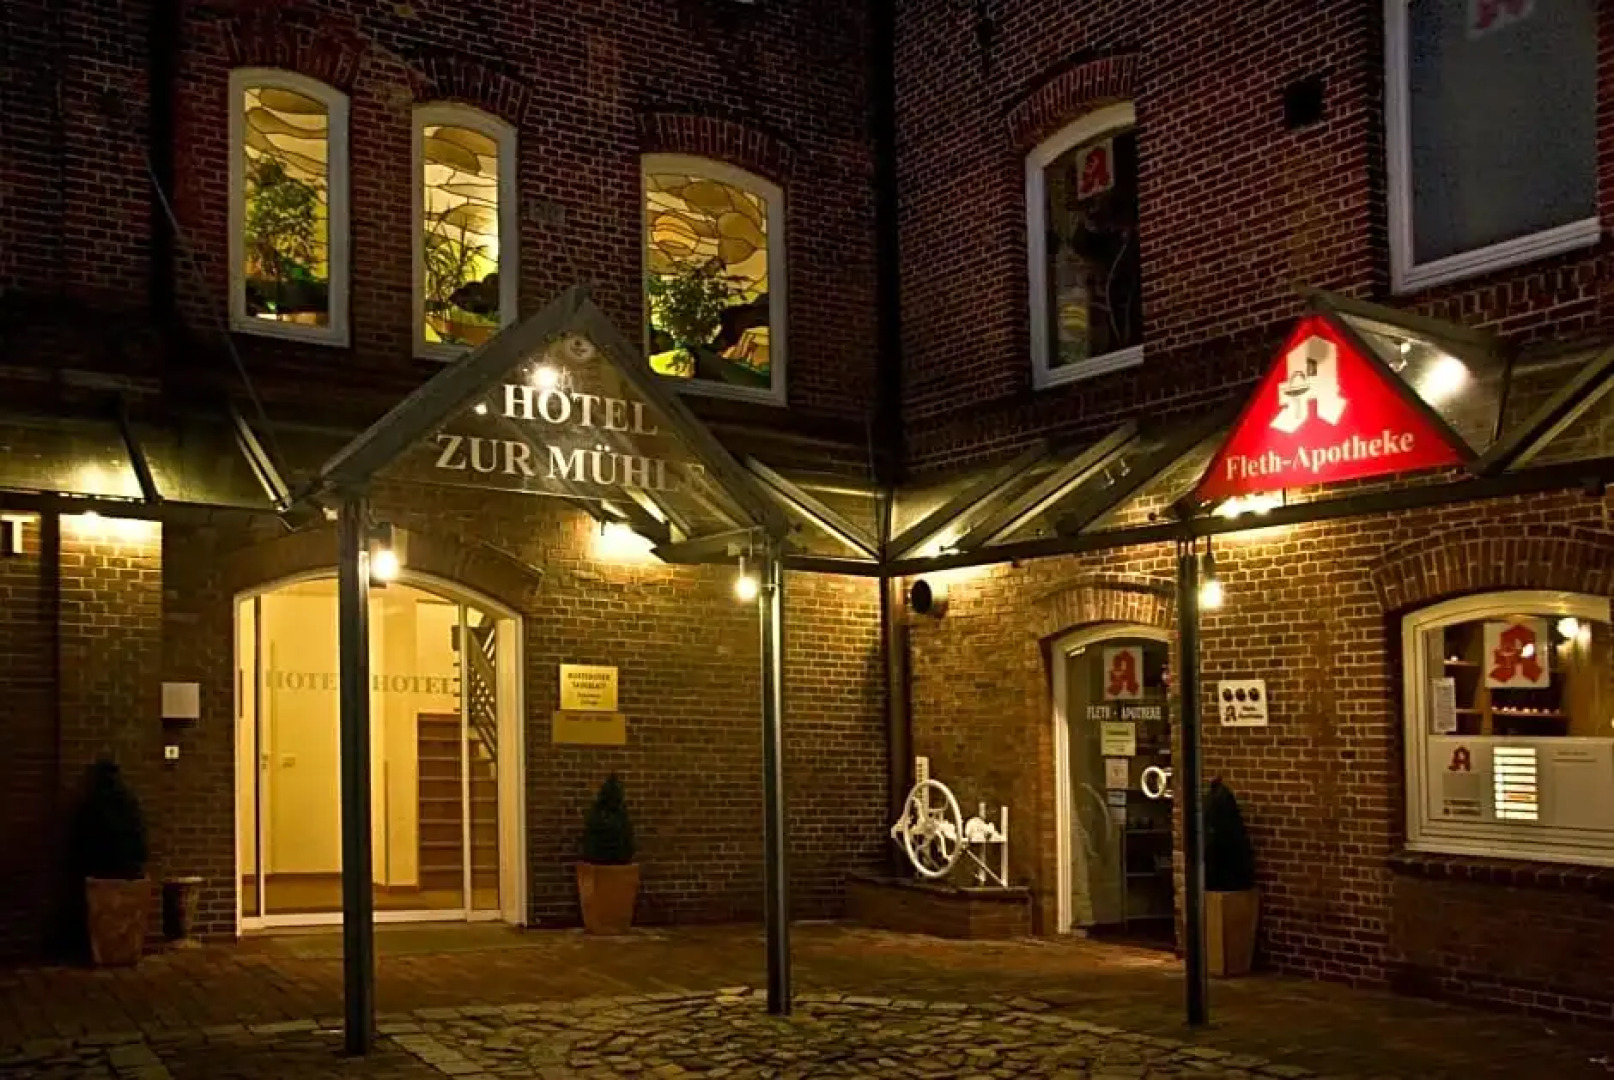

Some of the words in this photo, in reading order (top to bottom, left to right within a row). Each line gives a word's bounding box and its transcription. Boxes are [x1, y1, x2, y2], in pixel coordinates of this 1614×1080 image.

[501, 383, 658, 436] HOTEL
[435, 433, 535, 477] ZUR
[1225, 429, 1415, 482] Fleth-Apotheke
[265, 669, 338, 691] HOTE
